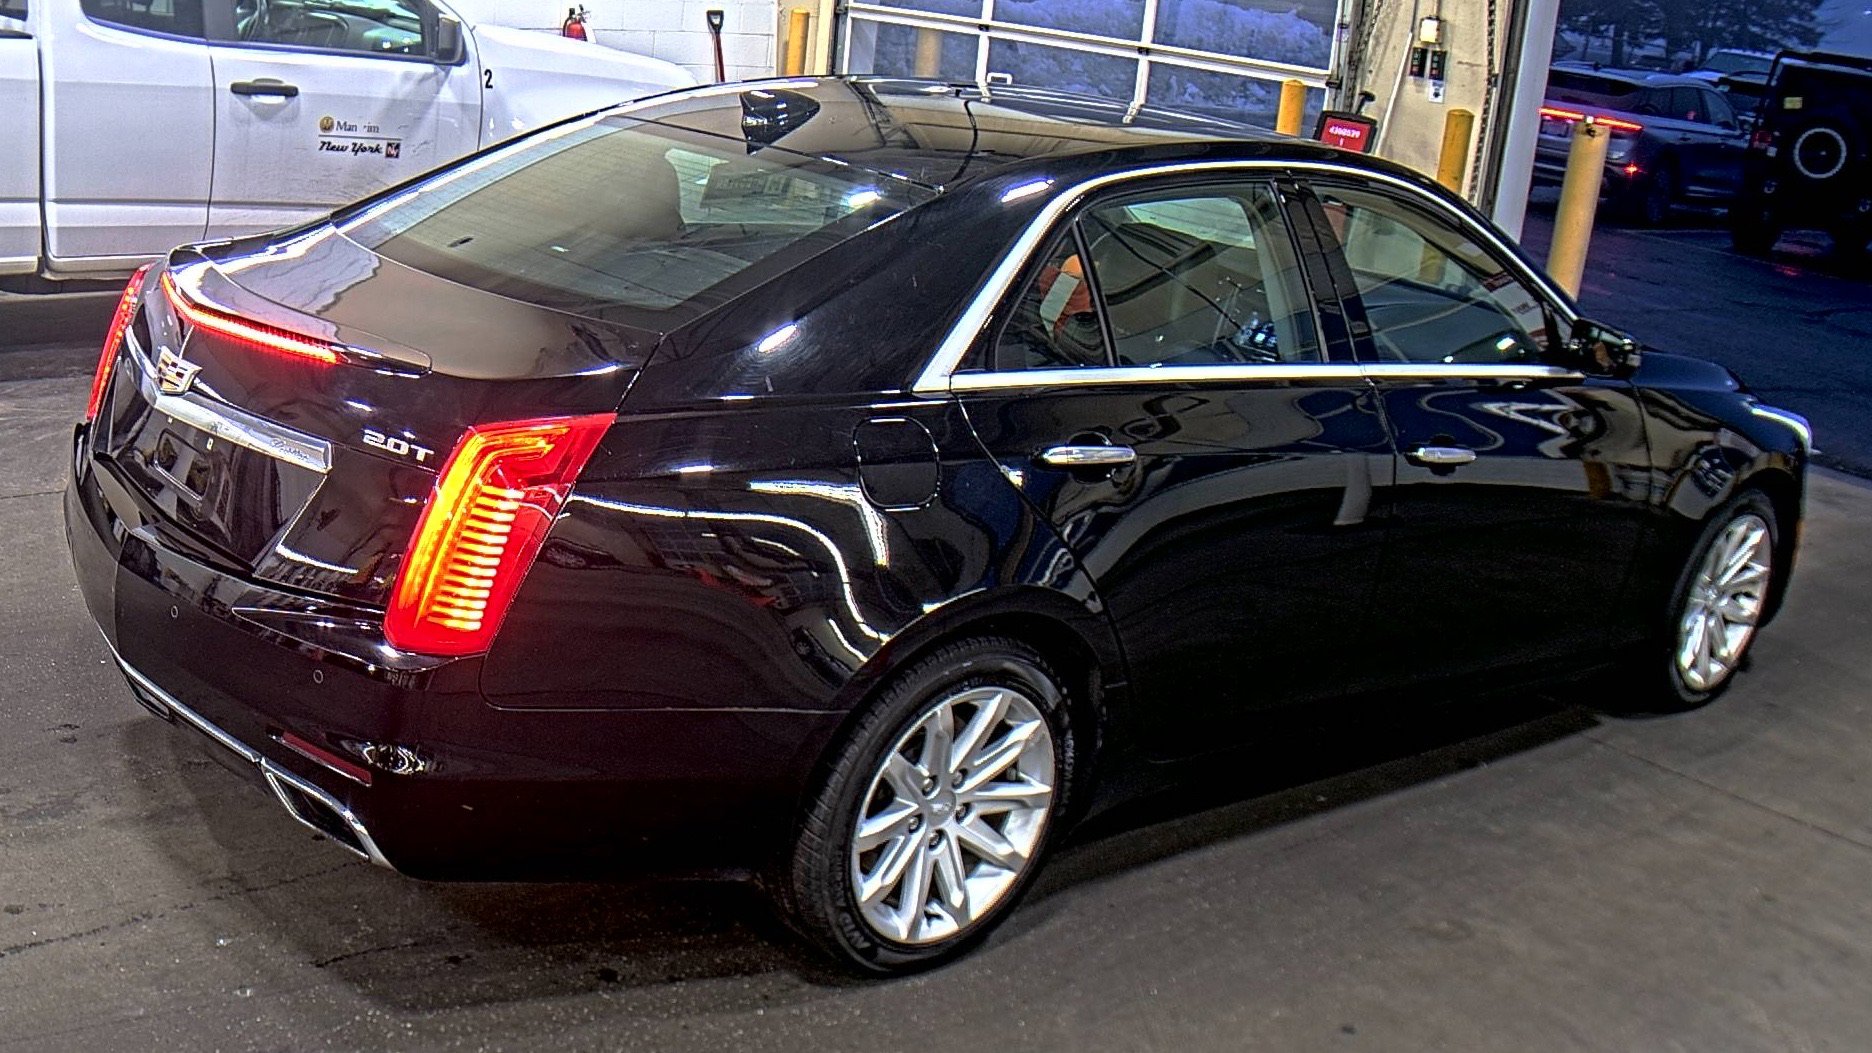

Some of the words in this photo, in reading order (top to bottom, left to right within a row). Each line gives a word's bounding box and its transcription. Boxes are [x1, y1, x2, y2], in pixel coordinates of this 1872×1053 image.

[484, 69, 493, 89] 2
[318, 141, 348, 151] New
[351, 142, 383, 156] York
